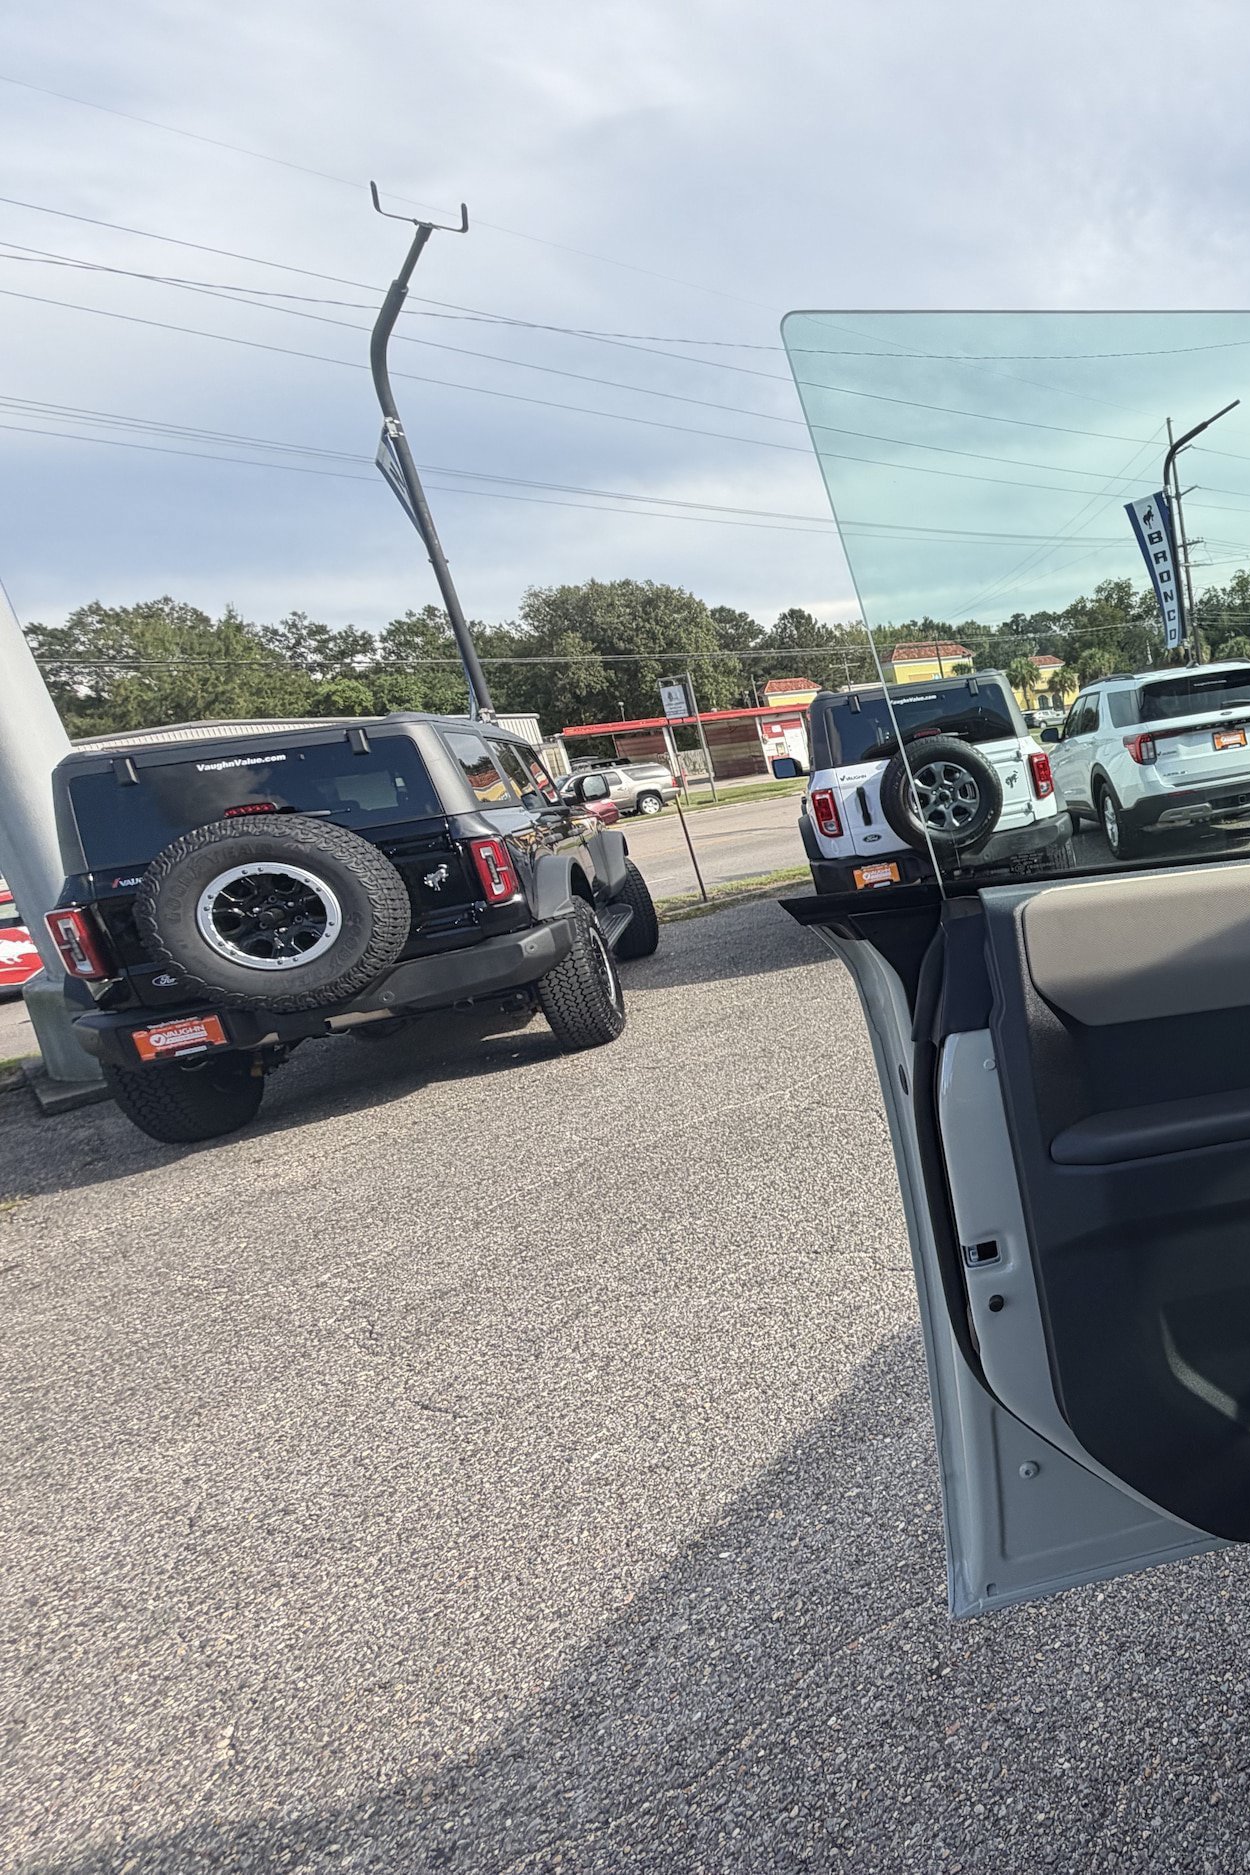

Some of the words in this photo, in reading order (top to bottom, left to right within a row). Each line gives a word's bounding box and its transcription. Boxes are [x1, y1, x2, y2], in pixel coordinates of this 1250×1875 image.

[1147, 530, 1177, 641] BRONCO
[196, 754, 287, 772] VaughnValue.com
[162, 1024, 206, 1038] VAUGHN
